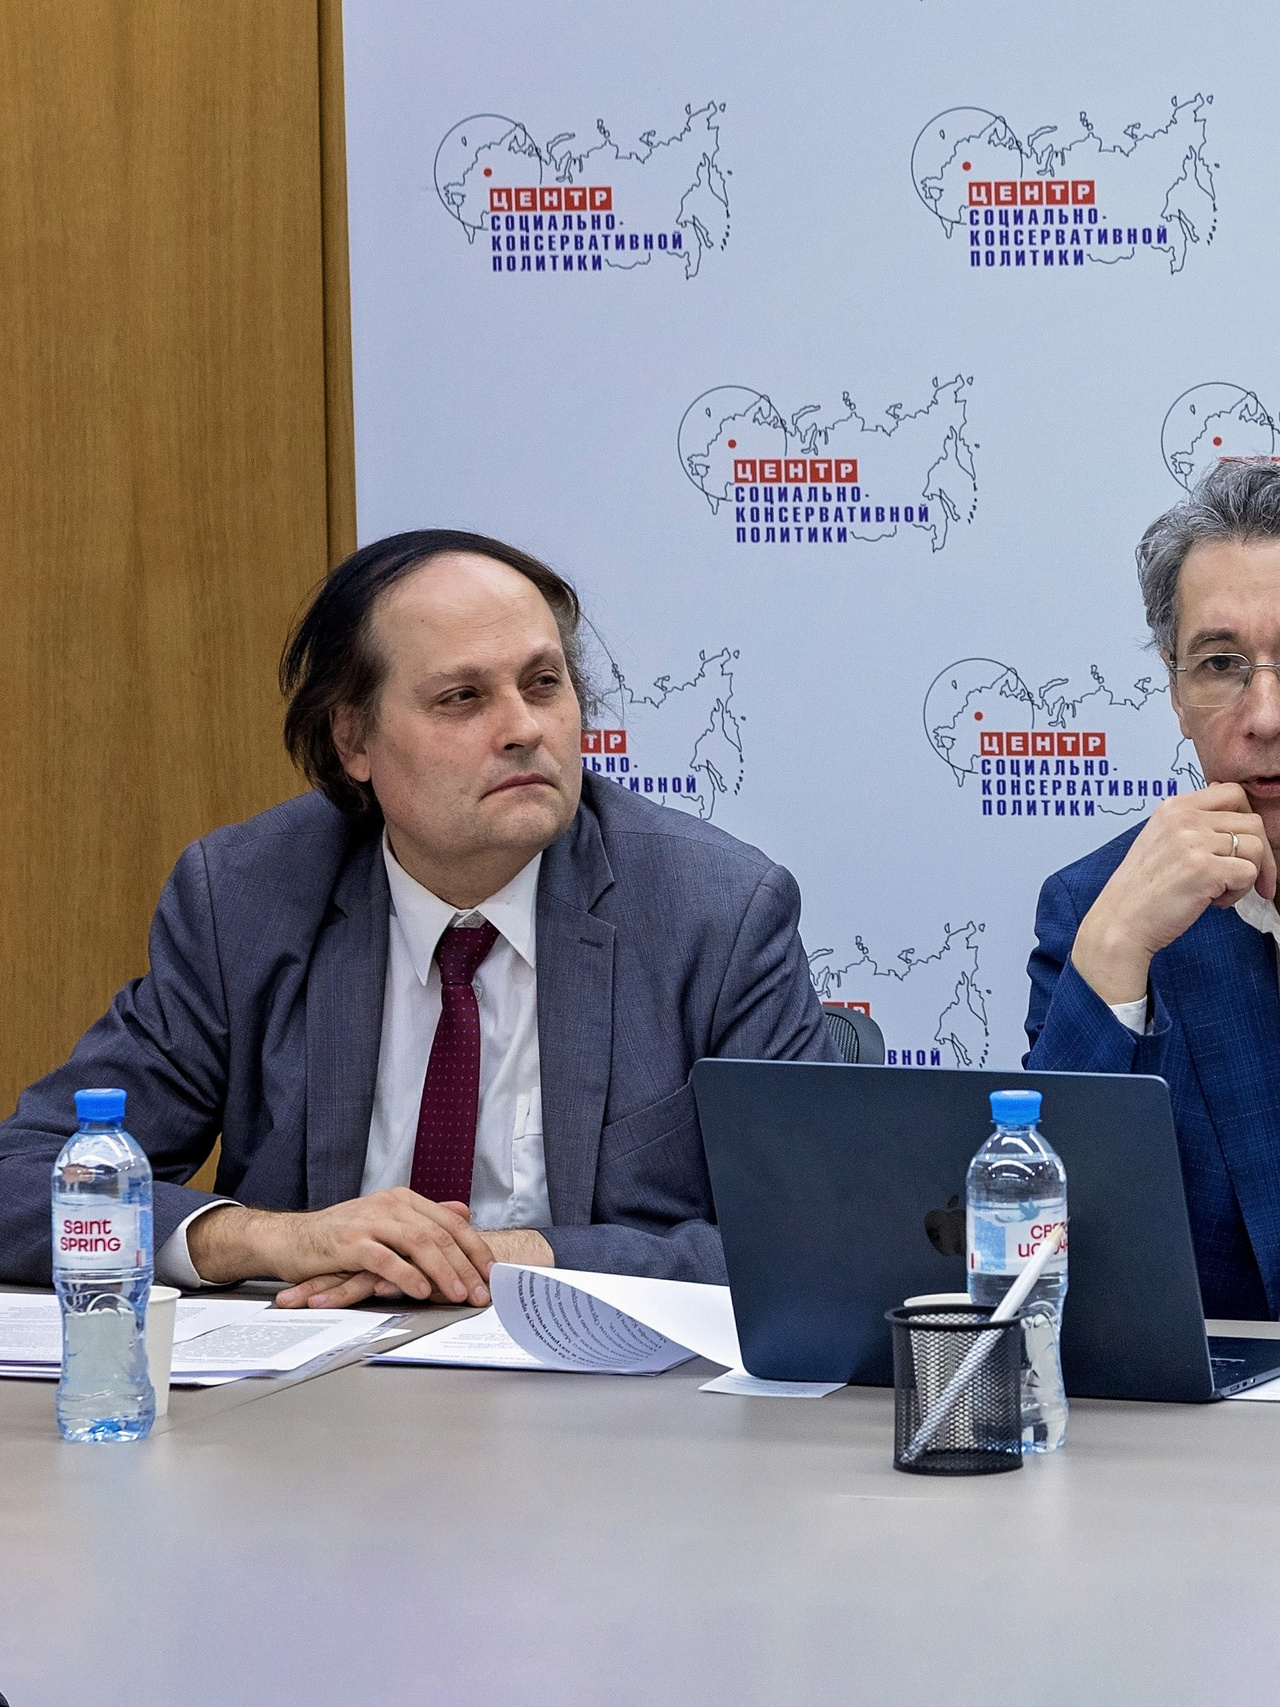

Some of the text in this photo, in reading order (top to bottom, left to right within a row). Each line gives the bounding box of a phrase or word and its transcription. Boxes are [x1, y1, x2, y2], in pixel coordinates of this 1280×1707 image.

[492, 189, 609, 210] ЦЕНТР
[971, 182, 1092, 204] ЦЕНТР
[491, 214, 624, 233] СОЦИАЛЬНО-
[970, 208, 1107, 227] СОЦИАЛЬНО-
[492, 230, 682, 251] КОНСЕРВАТИВНОЙ
[970, 225, 1166, 246] КОНСЕРВАТИВНОЙ
[493, 255, 601, 271] ПОЛИТИКИ
[971, 250, 1083, 266] ПОЛИТИКИ
[737, 461, 855, 481] ЦЕНТР
[736, 487, 869, 504] СОЦИАЛЬНО-
[736, 504, 928, 522] КОНСЕРВАТИВНОЙ
[737, 527, 846, 542] ПОЛИТИКИ
[983, 734, 1103, 755] ЦЕНТР
[982, 759, 1117, 777] СОЦИАЛЬНО-
[982, 778, 1177, 796] КОНСЕРВАТИВНОЙ
[983, 800, 1094, 816] ПОЛИТИКИ
[60, 1237, 121, 1252] SPRING
